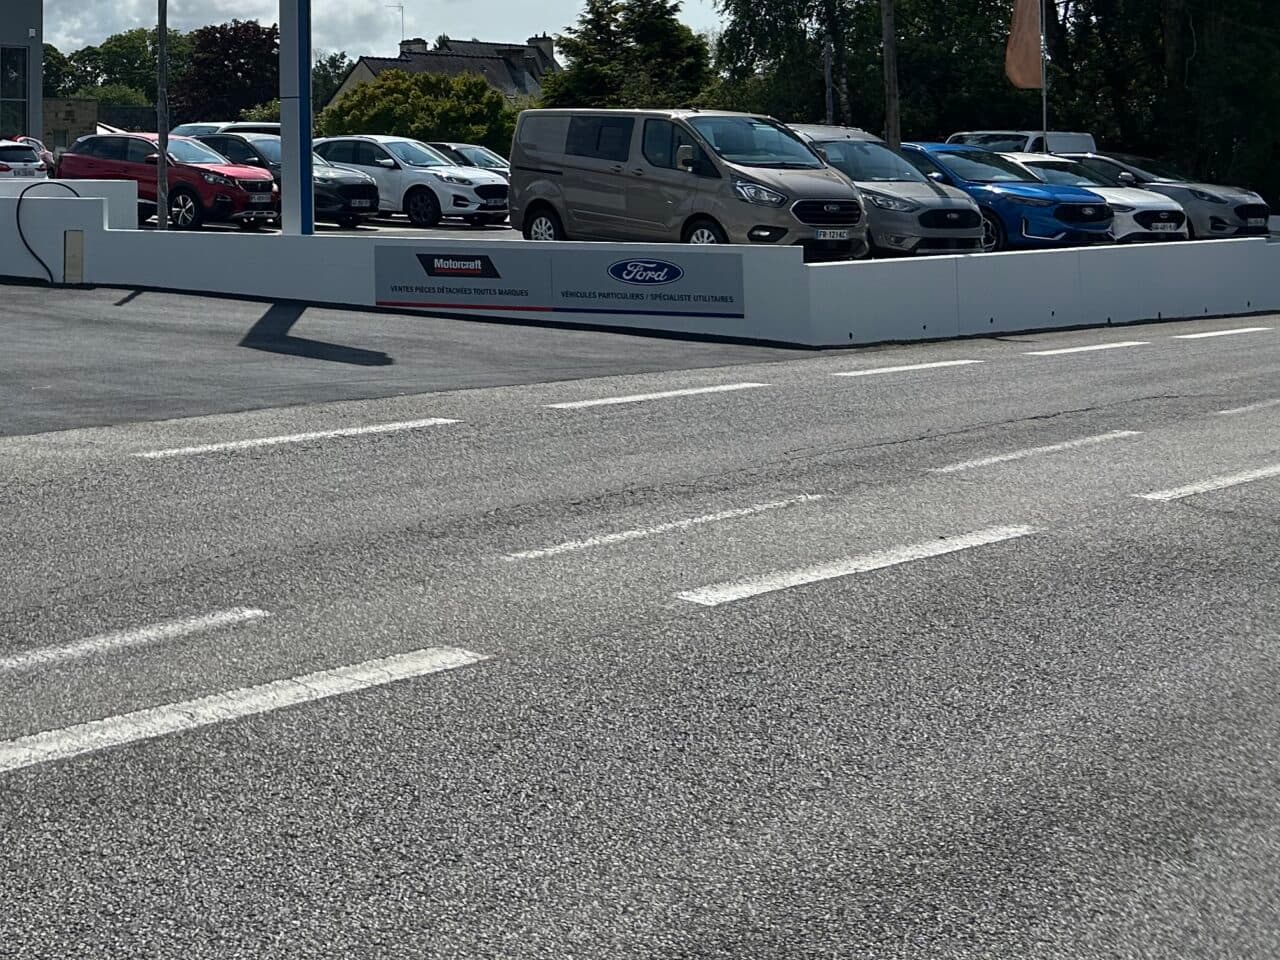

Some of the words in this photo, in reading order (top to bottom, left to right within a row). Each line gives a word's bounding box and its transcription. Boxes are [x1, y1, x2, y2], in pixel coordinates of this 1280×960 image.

[433, 258, 482, 270] Motorcraft
[622, 261, 668, 281] Ford
[390, 284, 414, 293] VENTES
[474, 287, 497, 296] TOUTES
[498, 288, 529, 297] MARQUES
[598, 292, 644, 300] PARTICULIERS
[650, 292, 691, 302] SPÉCIALISTE
[693, 294, 734, 303] UTILITAIRES
